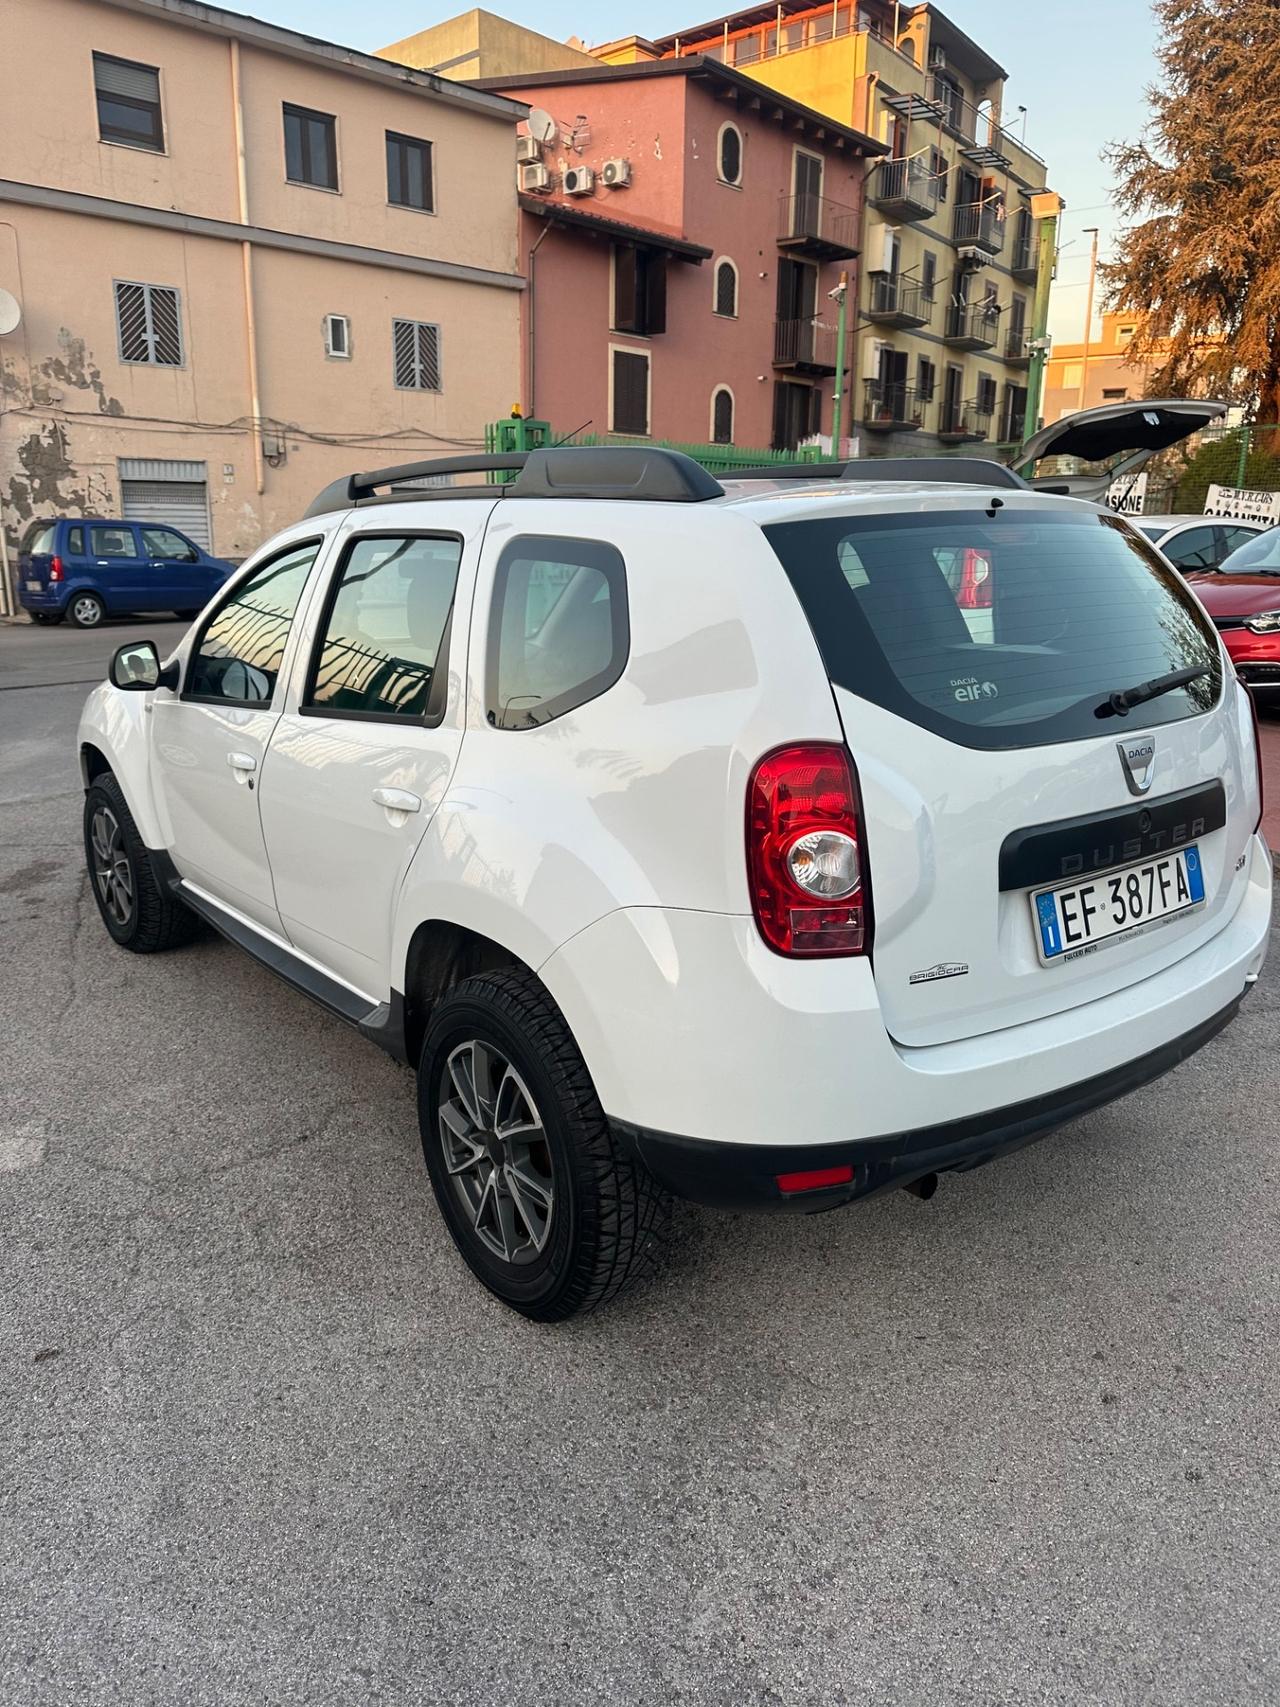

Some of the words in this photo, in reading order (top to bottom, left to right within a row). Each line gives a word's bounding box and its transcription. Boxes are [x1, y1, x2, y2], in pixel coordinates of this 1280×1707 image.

[950, 677, 978, 687] DACIA
[955, 684, 981, 701] elf
[1128, 746, 1153, 759] DACIA
[1061, 817, 1206, 875] DUSTER
[1060, 886, 1096, 943] EF
[1108, 857, 1190, 925] 387FA
[909, 965, 969, 981] BRIGIOCAR
